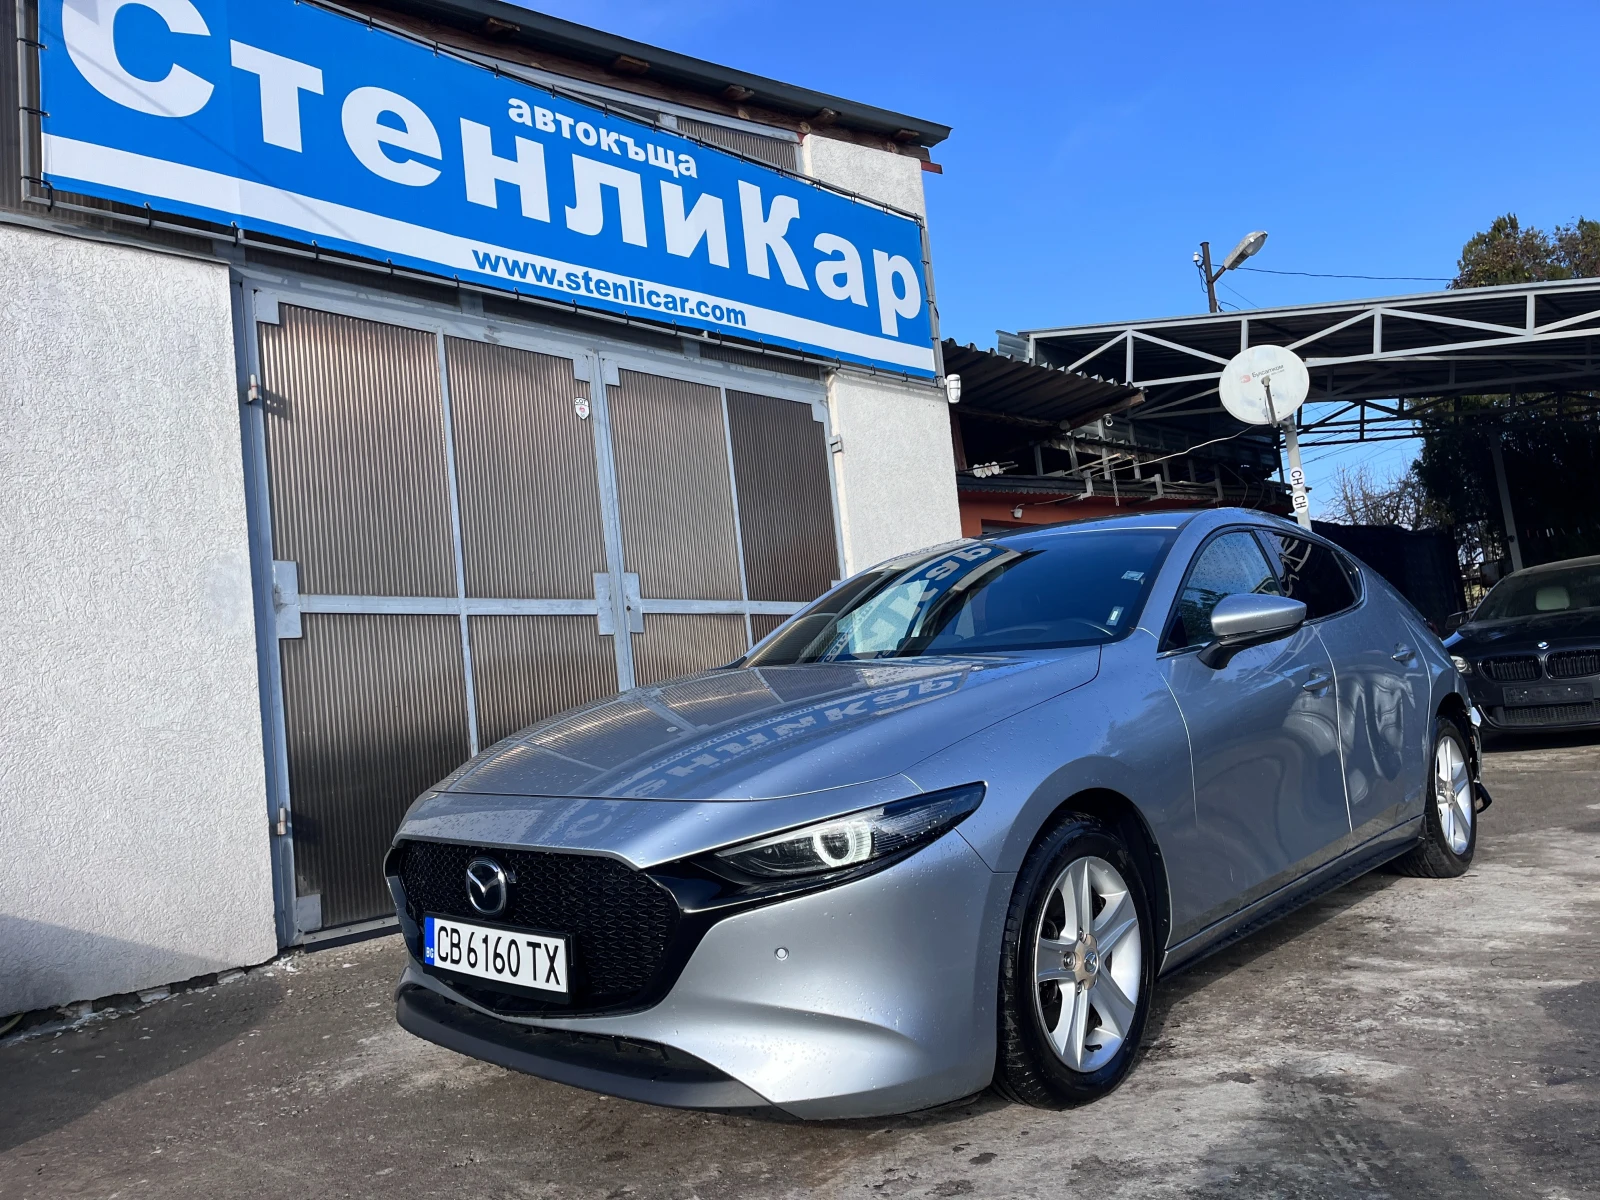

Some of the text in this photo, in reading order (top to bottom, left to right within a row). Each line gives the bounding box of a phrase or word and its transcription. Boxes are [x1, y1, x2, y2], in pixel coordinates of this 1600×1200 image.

[62, 0, 921, 337] СтенлиКар
[508, 97, 698, 179] автокъща
[471, 249, 747, 327] www.stenlicar.com
[1291, 470, 1304, 486] CH
[1294, 495, 1307, 510] CH
